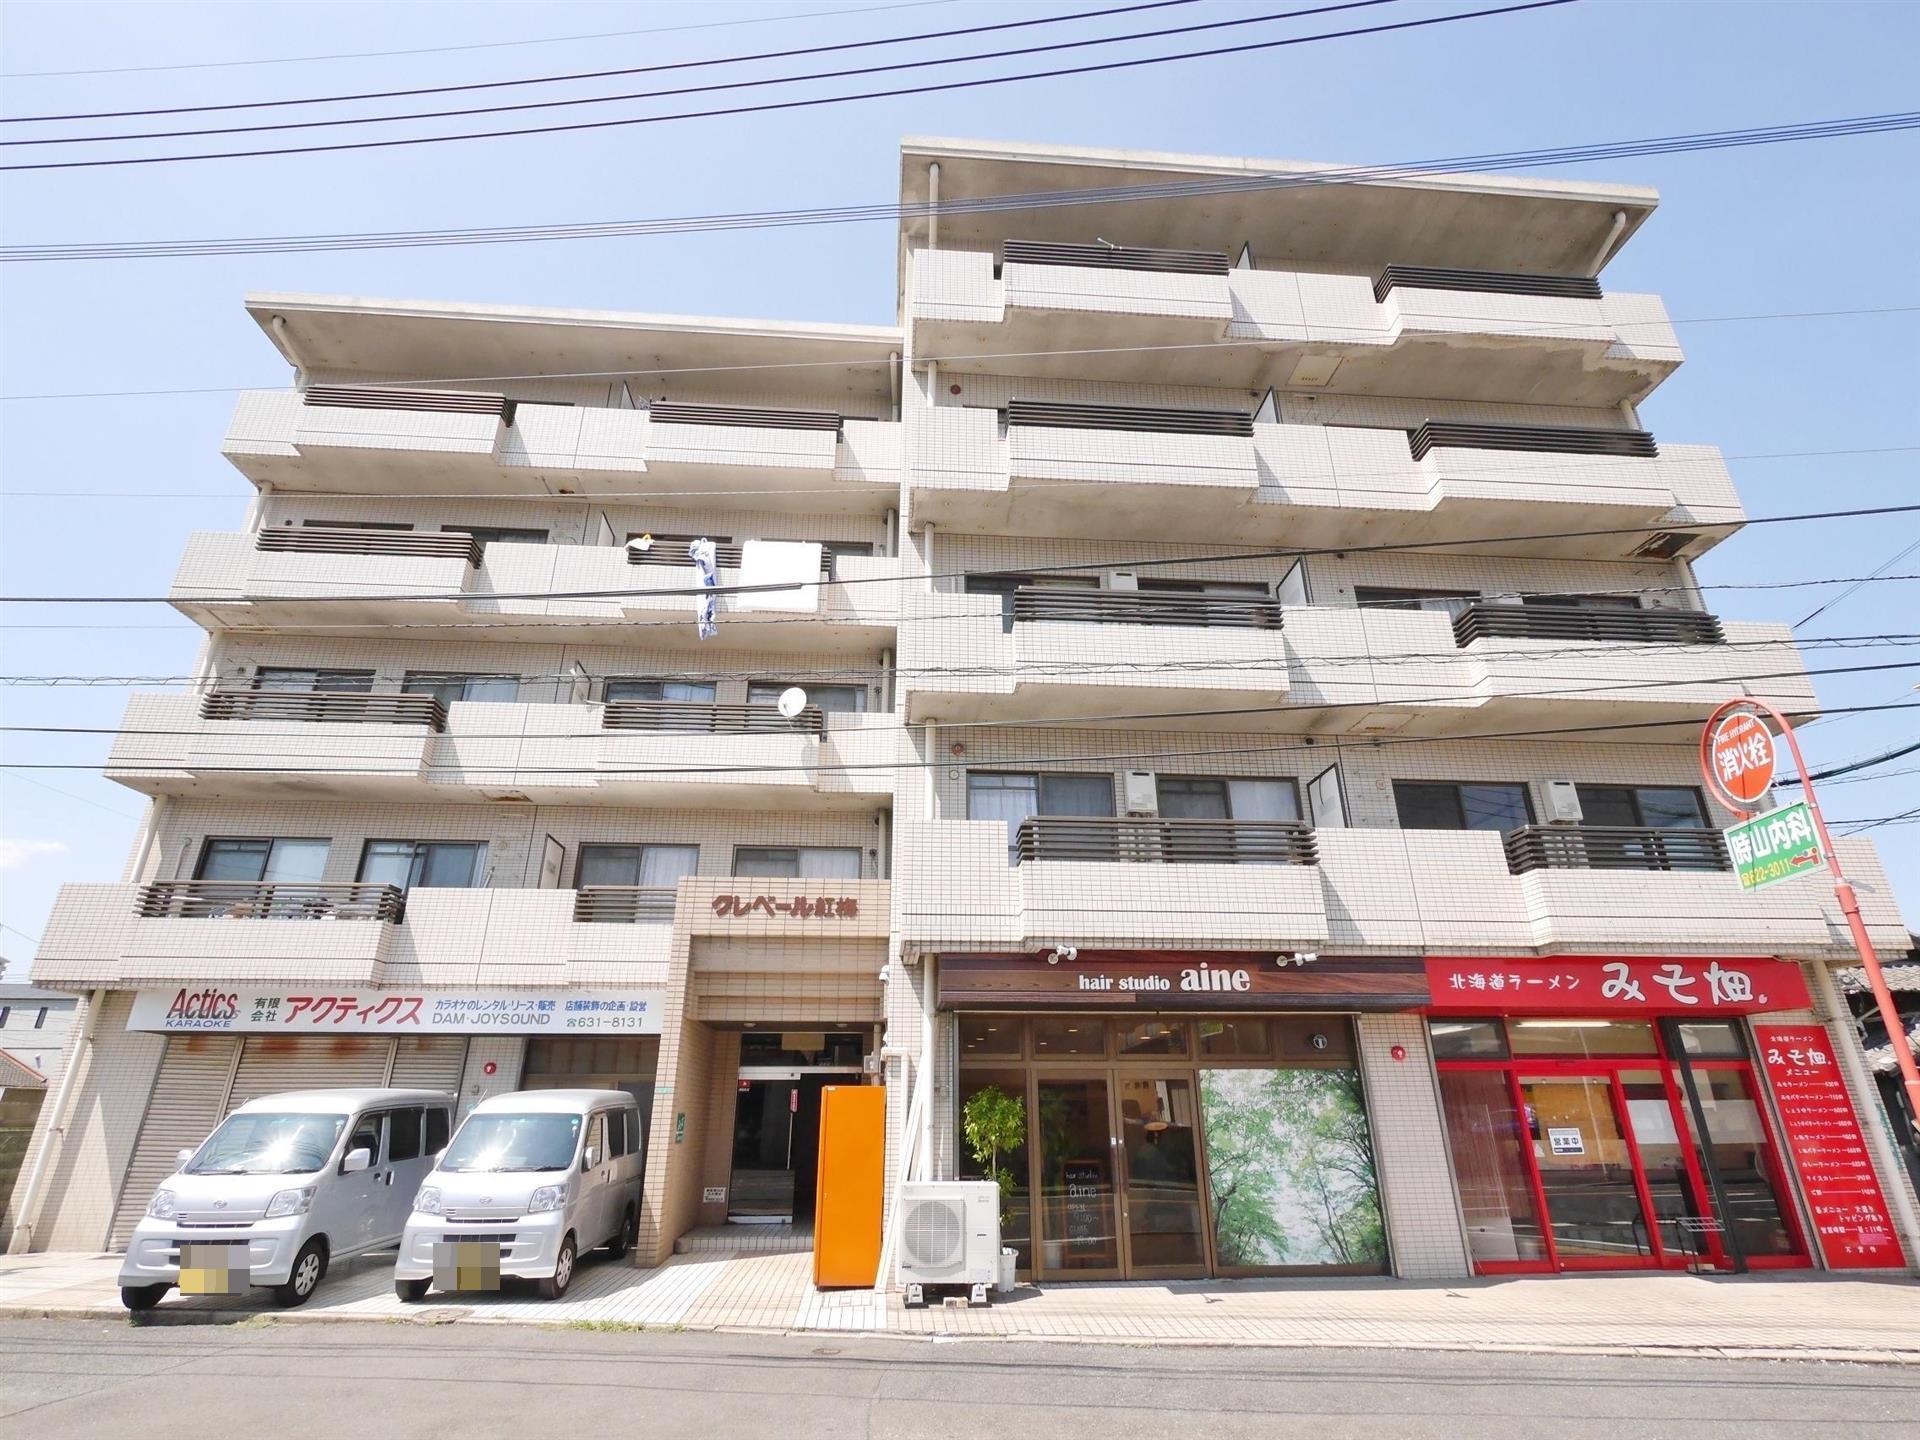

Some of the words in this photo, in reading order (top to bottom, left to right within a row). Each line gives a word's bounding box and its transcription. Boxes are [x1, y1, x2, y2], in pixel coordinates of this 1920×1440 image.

[1717, 733, 1771, 782] 消火栓
[1730, 808, 1812, 865] 時山内科
[1079, 974, 1113, 990] hair
[1118, 974, 1170, 991] studio
[1180, 962, 1251, 991] aine
[1449, 973, 1580, 991] 北海道ラーメン
[166, 988, 239, 1019] Actics
[254, 997, 280, 1009] 有限
[285, 997, 424, 1025] アクティクス
[166, 1019, 231, 1028] KARAOKE
[251, 1009, 277, 1022] 会社
[1786, 1068, 1819, 1076] メニュー
[1554, 1137, 1579, 1146] 営業中
